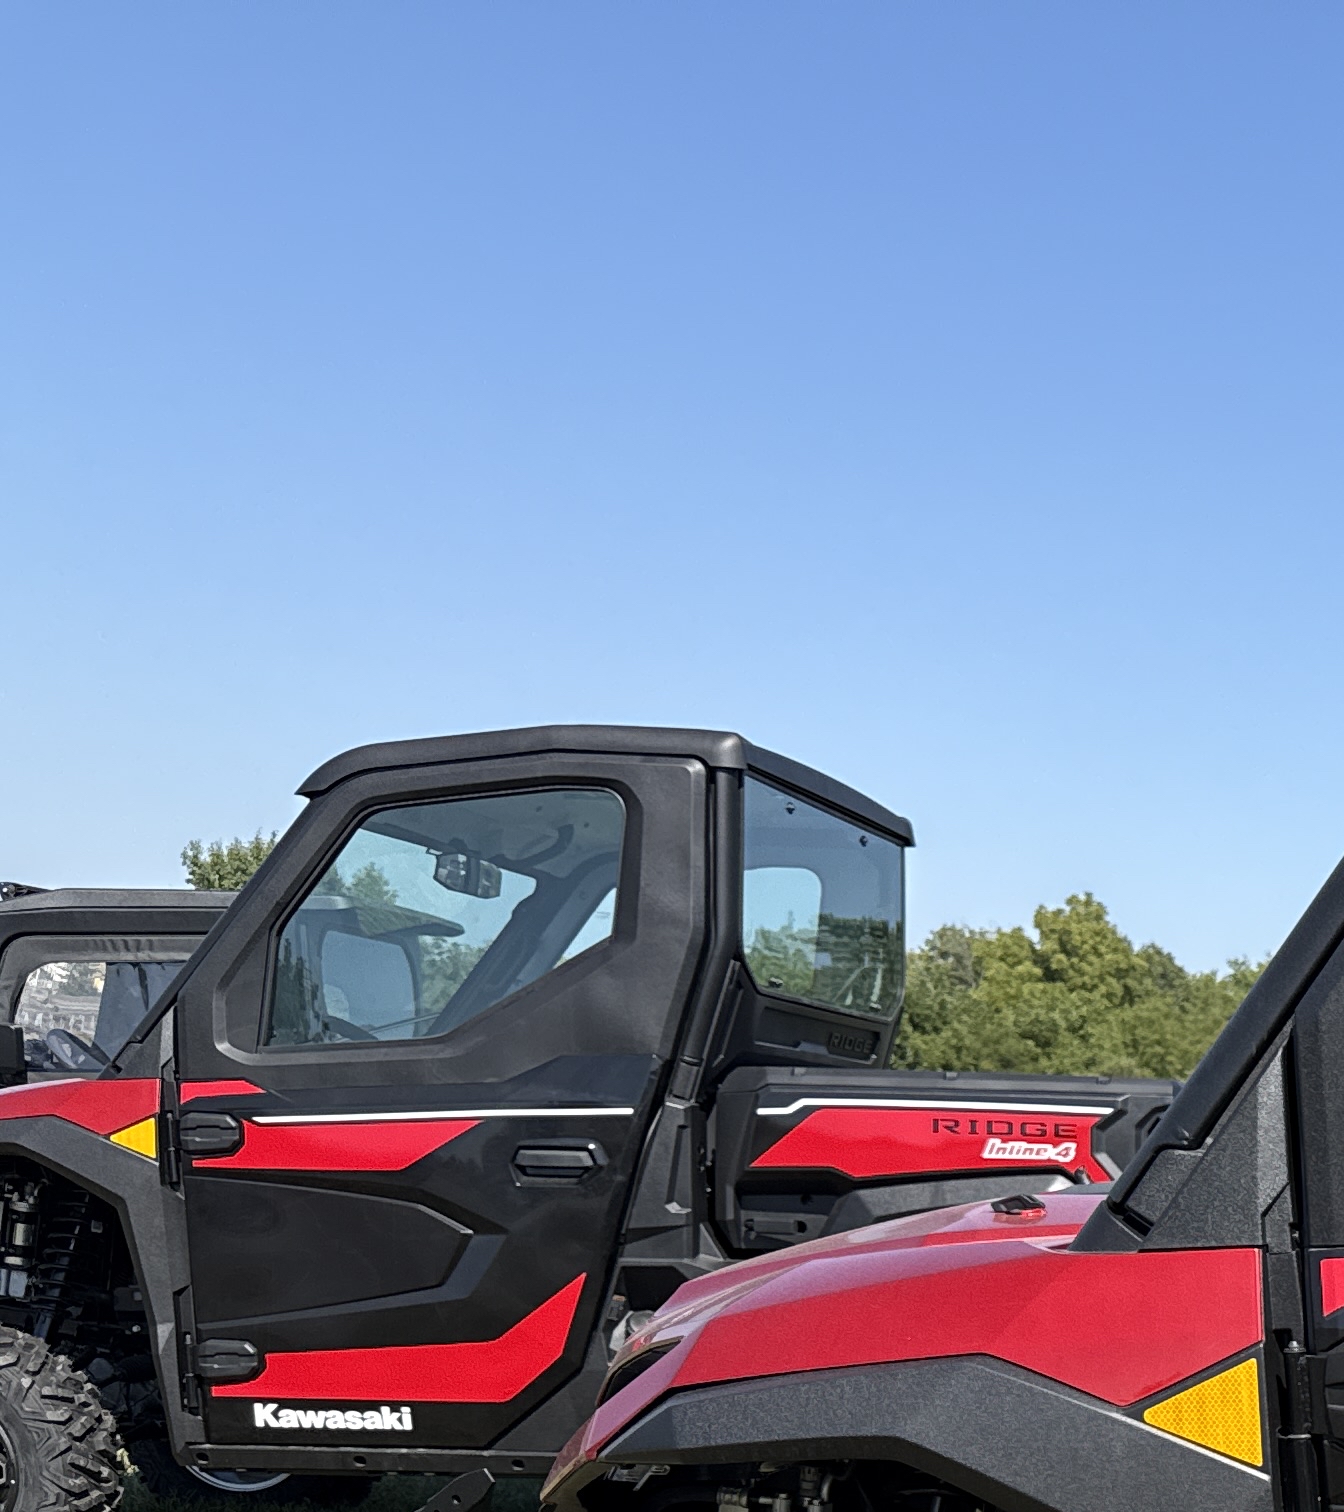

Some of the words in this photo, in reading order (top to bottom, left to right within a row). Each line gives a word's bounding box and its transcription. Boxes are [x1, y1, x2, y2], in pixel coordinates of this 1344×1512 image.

[830, 1031, 873, 1053] RIDGE
[932, 1117, 1078, 1140] RIDGE
[253, 1402, 413, 1431] Kawasaki
